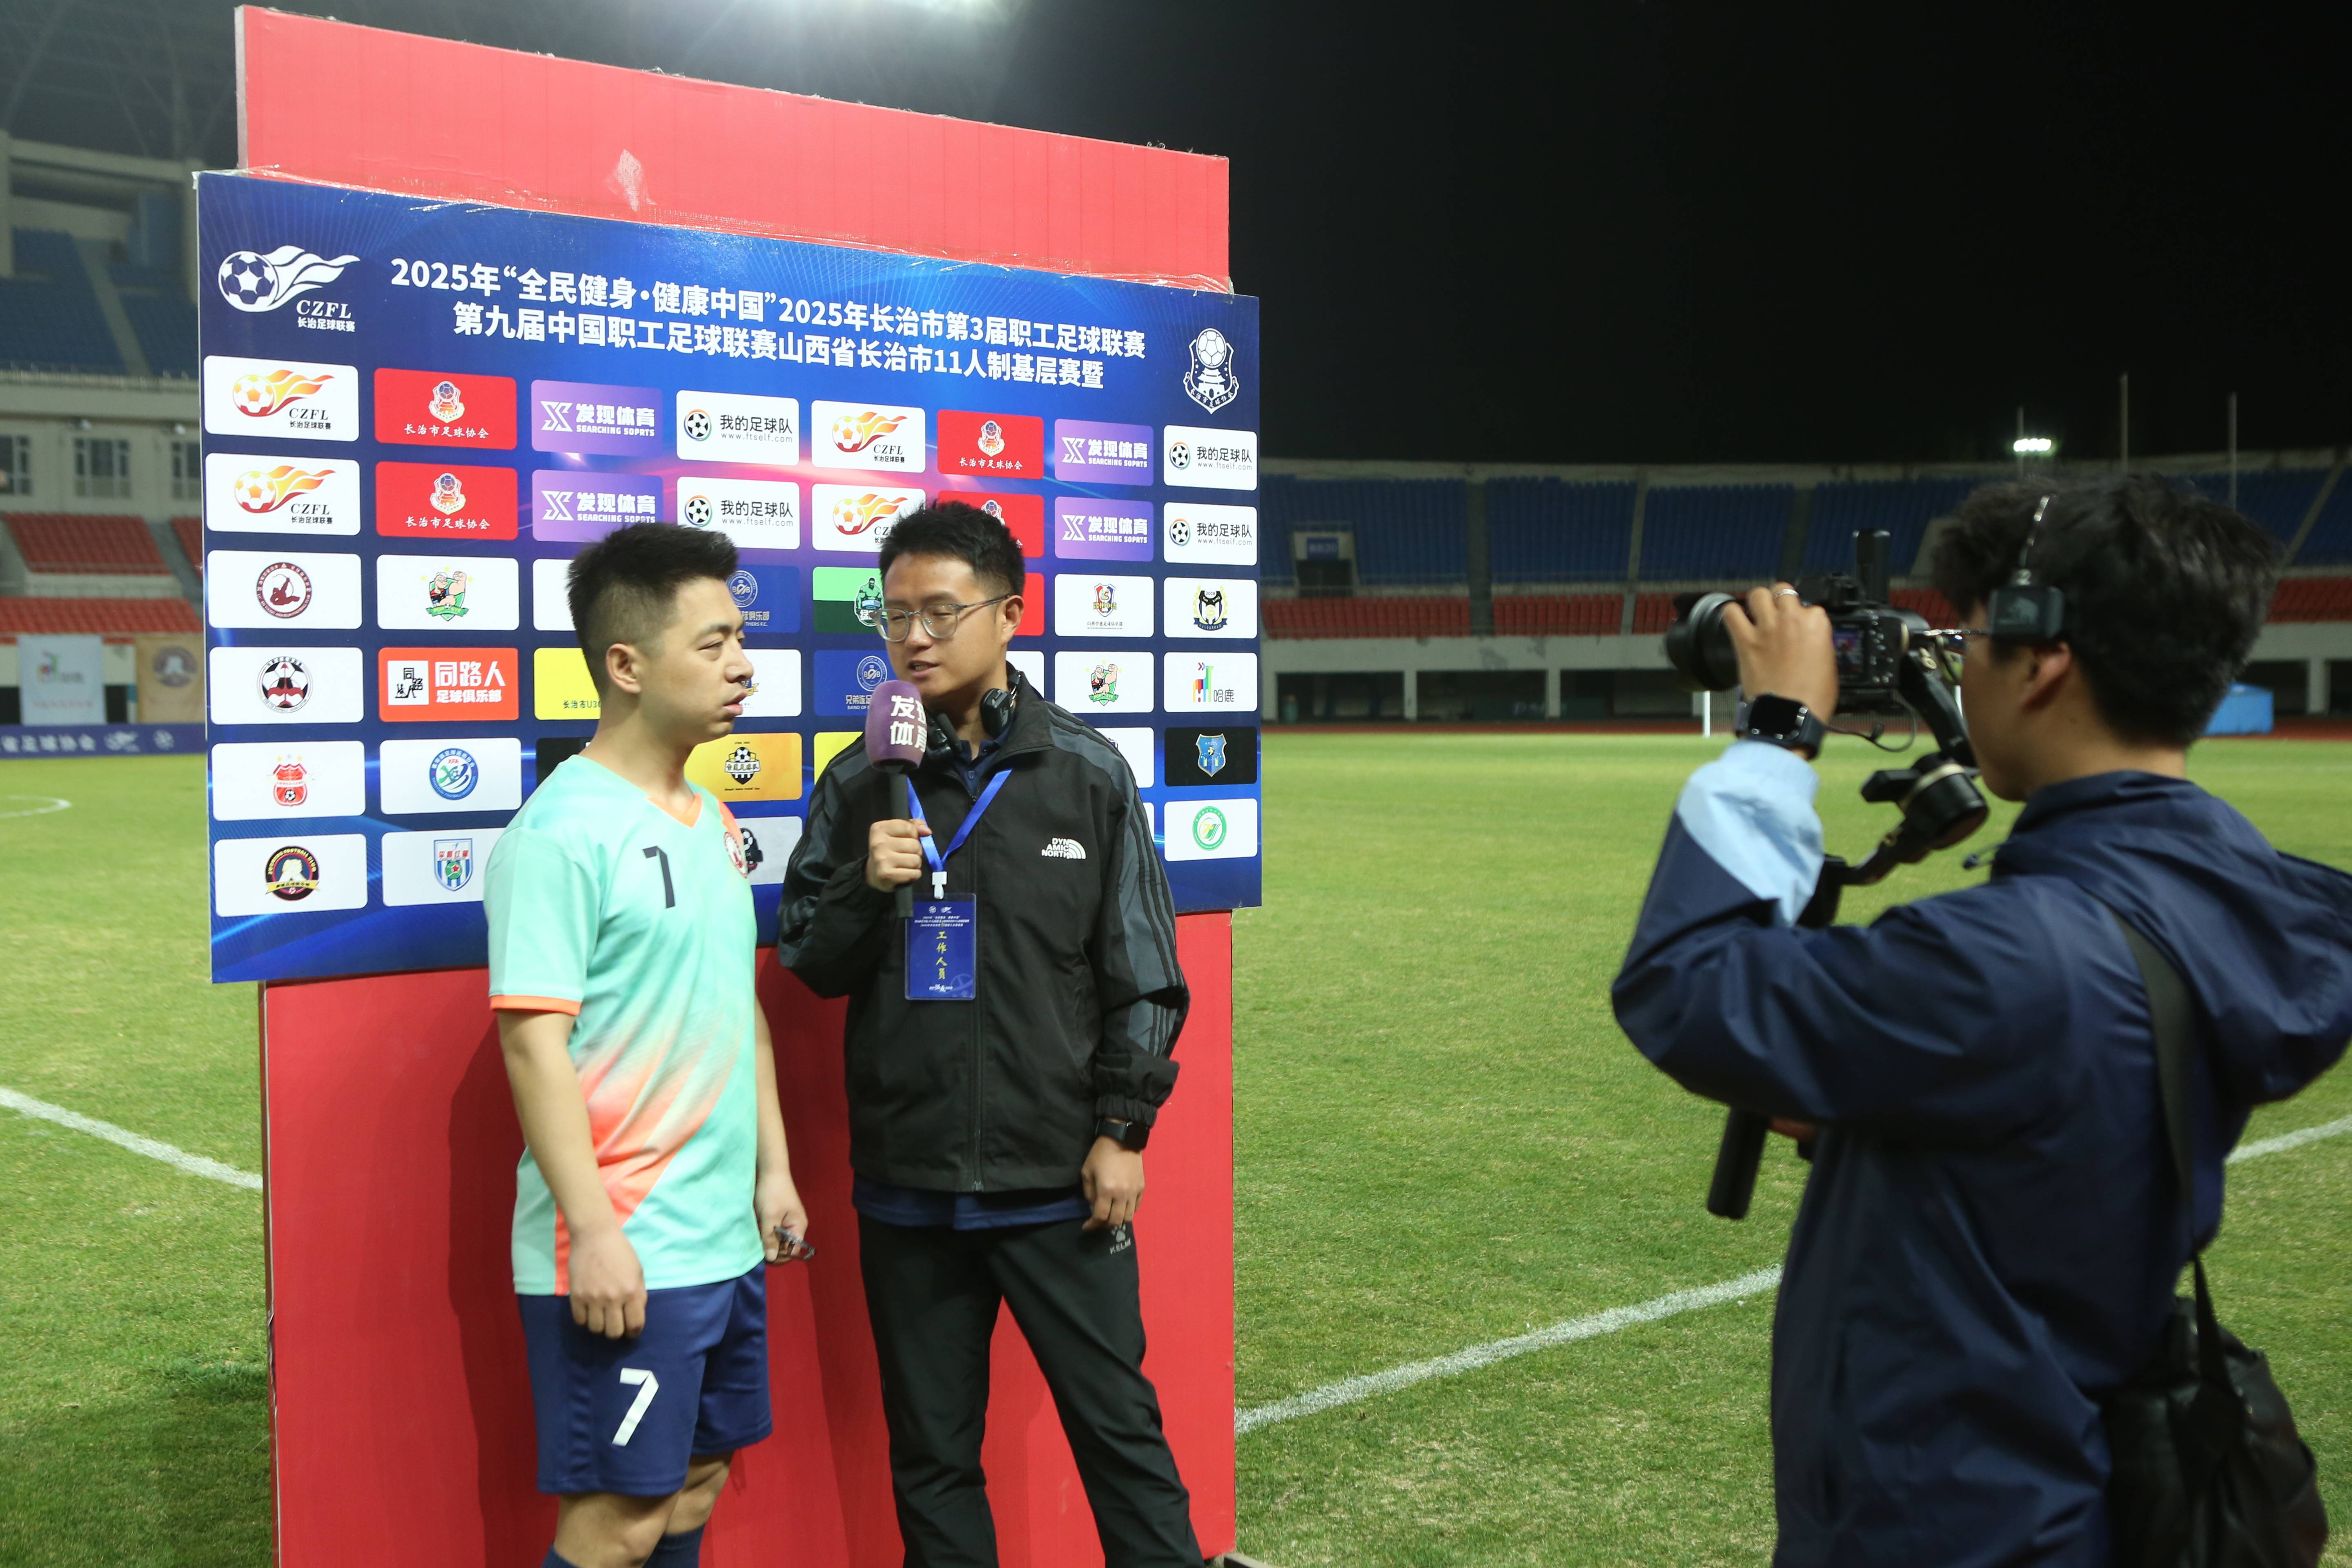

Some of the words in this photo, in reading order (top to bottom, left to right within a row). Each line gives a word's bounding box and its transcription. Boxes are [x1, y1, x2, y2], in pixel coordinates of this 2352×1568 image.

[297, 300, 351, 320] CZFL
[391, 258, 1145, 360] 2025年“全民健身·健康中国”2025年长治市第3届职工足球联赛
[298, 316, 355, 332] 长治足球联赛
[453, 301, 1104, 389] 第九届中国职工足球联赛山西省长治市11人制基层赛暨
[290, 409, 328, 420] CZFL
[576, 403, 655, 427] 发现体育
[290, 421, 331, 429] 长治足球联赛
[404, 421, 488, 438] 长治市足球协会
[576, 425, 621, 434] SEARCHING
[624, 428, 655, 437] SOPRTS
[720, 415, 792, 436] 我的足球队
[721, 432, 792, 442] www.ftself.com
[874, 445, 902, 454] CZFL
[1088, 439, 1148, 459] 发现体育
[1197, 447, 1252, 462] 我的足球队
[960, 455, 1022, 470] 长治市足球协会
[1088, 457, 1122, 466] SEARCHING
[1124, 459, 1148, 468] SOPRTS
[1198, 461, 1252, 470] www.ftself.com
[291, 504, 329, 514] CZFL
[577, 492, 655, 514] 发现体育
[721, 500, 793, 517] 我的足球队
[292, 514, 332, 524] 长治足球联赛
[405, 514, 490, 529] 长治市足球协会
[577, 513, 622, 523] SEARCHING
[722, 516, 793, 526] www.ftself.com
[1088, 516, 1148, 535] 发现体育
[1197, 523, 1252, 537] 我的足球队
[1088, 534, 1122, 543] SEARCHING
[1124, 535, 1148, 544] SOPRTS
[1198, 537, 1252, 545] www.ftself.com
[435, 661, 506, 687] 同路人
[436, 689, 502, 703] 足球俱乐部
[846, 695, 872, 705] 兄弟连足
[1214, 689, 1234, 702] 哈鹿
[1041, 849, 1069, 859] NORTH
[1046, 844, 1069, 852] AMIC
[935, 931, 948, 980] 工作人员
[613, 1368, 659, 1445] 7
